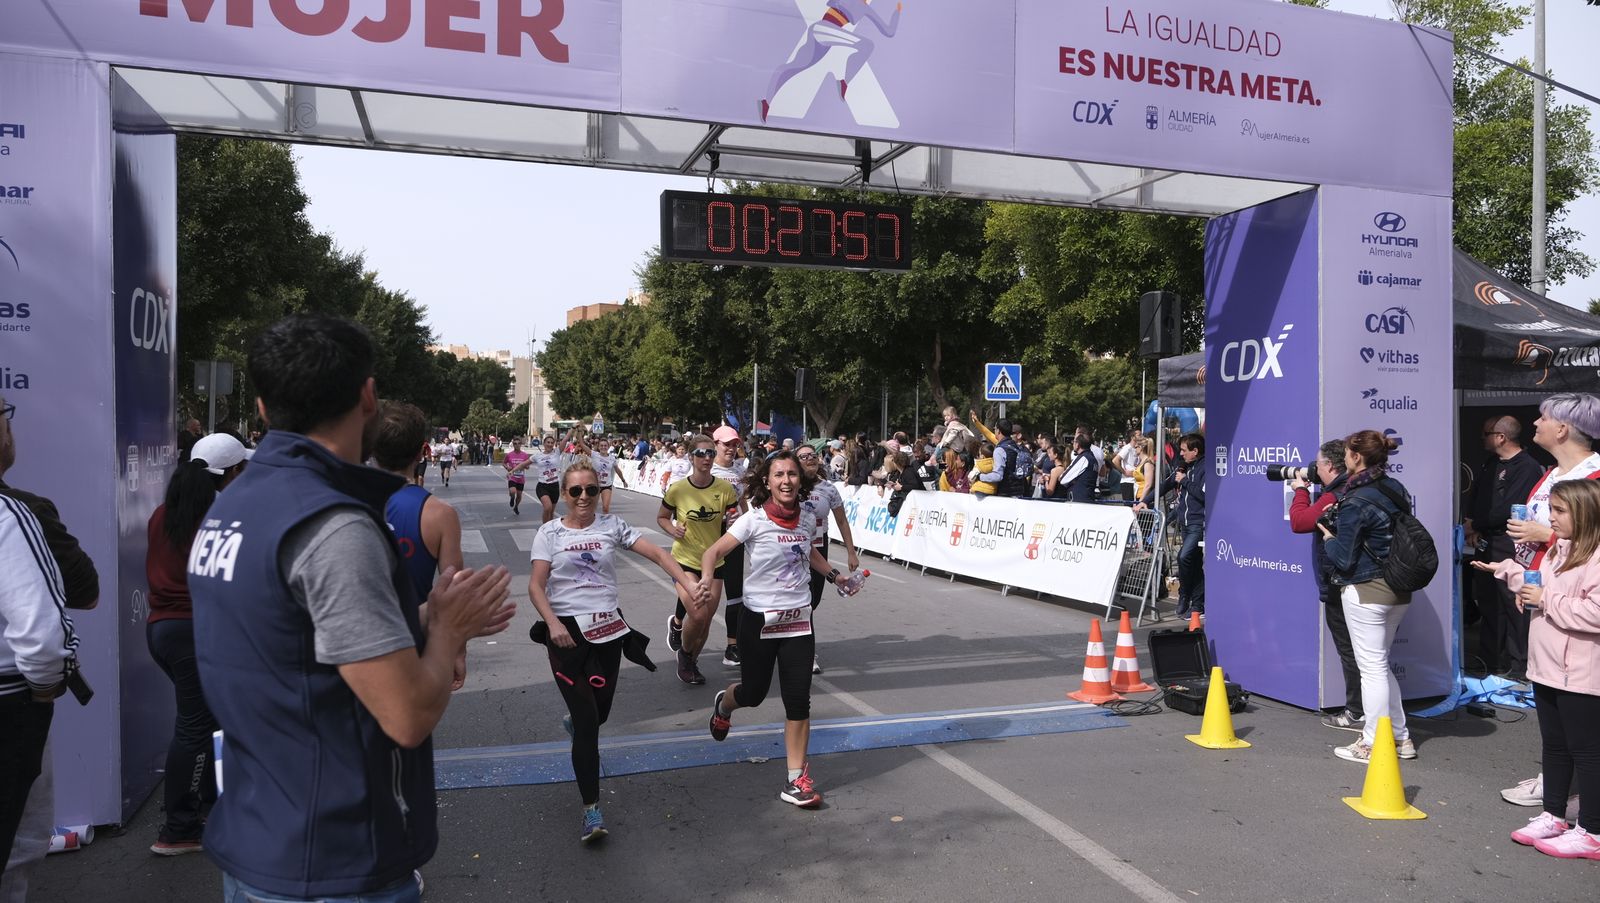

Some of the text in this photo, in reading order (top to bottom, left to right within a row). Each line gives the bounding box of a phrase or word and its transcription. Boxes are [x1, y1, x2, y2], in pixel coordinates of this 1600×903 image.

[1106, 6, 1281, 57] LA IGUALDAD
[1059, 46, 1322, 106] ES NUESTRA META.
[1073, 100, 1118, 125] CDX
[1168, 109, 1217, 126] ALMERÍA
[1168, 122, 1193, 132] CIUDAD
[708, 201, 899, 261] 00:27:57
[1362, 234, 1418, 248] HYUNDAI
[1369, 247, 1412, 258] Almerialva
[1376, 273, 1422, 287] cajamar
[130, 287, 170, 354] CDX
[1365, 314, 1405, 334] CASI
[1220, 324, 1294, 382] CDX
[1378, 349, 1419, 364] vithas
[1370, 396, 1418, 413] aqualia
[1238, 443, 1302, 462] ALMERÍA
[1237, 464, 1267, 475] CIUDAD
[972, 517, 1025, 540] ALMERÍA
[970, 536, 997, 550] CIUDAD
[1053, 526, 1118, 551] ALMERÍA
[1051, 548, 1083, 563] CIUDAD
[777, 608, 800, 621] 750
